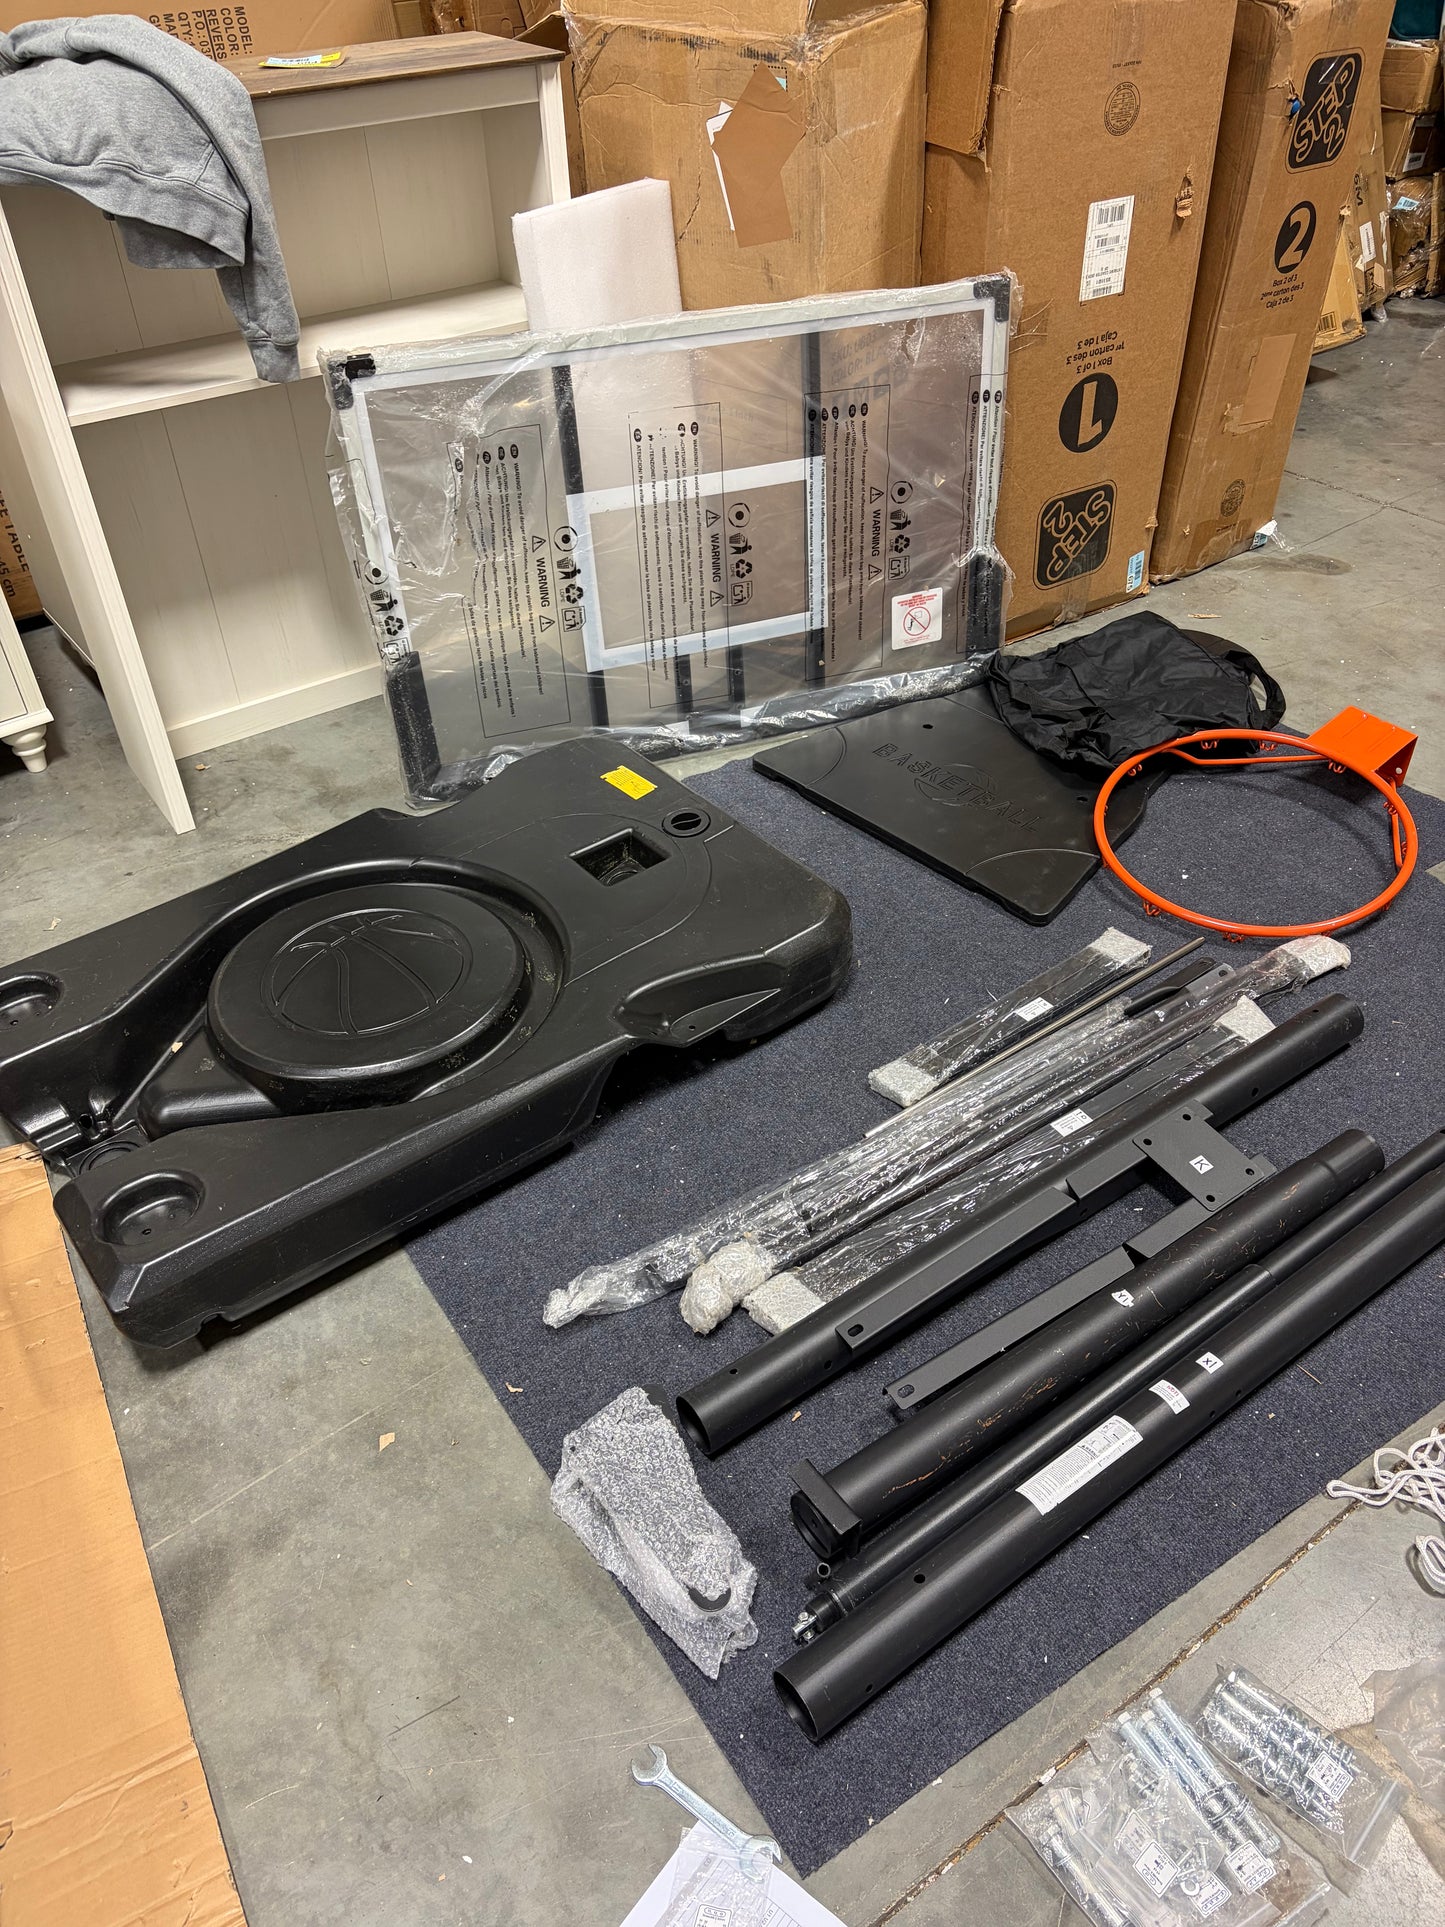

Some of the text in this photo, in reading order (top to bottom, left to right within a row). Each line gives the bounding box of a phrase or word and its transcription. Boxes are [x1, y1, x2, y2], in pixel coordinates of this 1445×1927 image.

[220, 7, 240, 56] COLOR:
[234, 6, 253, 55] MODEL:
[1294, 57, 1356, 163] STEP
[1323, 113, 1346, 159] 2
[1277, 207, 1312, 269] 2
[1272, 278, 1283, 287] Box
[1283, 276, 1288, 285] 2
[1288, 274, 1294, 283] of
[1273, 287, 1290, 297] carton
[1291, 284, 1300, 292] des
[1266, 298, 1278, 308] Caja
[1283, 296, 1290, 304] de
[1084, 337, 1095, 347] de
[1101, 331, 1118, 343] Caja
[1077, 340, 1083, 350] 3
[1089, 343, 1115, 355] carton
[1066, 355, 1072, 365] 3
[1073, 350, 1088, 362] des
[1098, 356, 1113, 367] Box
[1076, 365, 1082, 374] 3
[1082, 363, 1092, 373] of
[1077, 380, 1103, 448] 1
[871, 509, 881, 557] WARNING
[1046, 490, 1111, 581] STEP
[711, 533, 721, 583] WARNING
[536, 557, 550, 608] WARNING
[872, 743, 1043, 833] BASKETBALL
[1194, 1158, 1210, 1171] K
